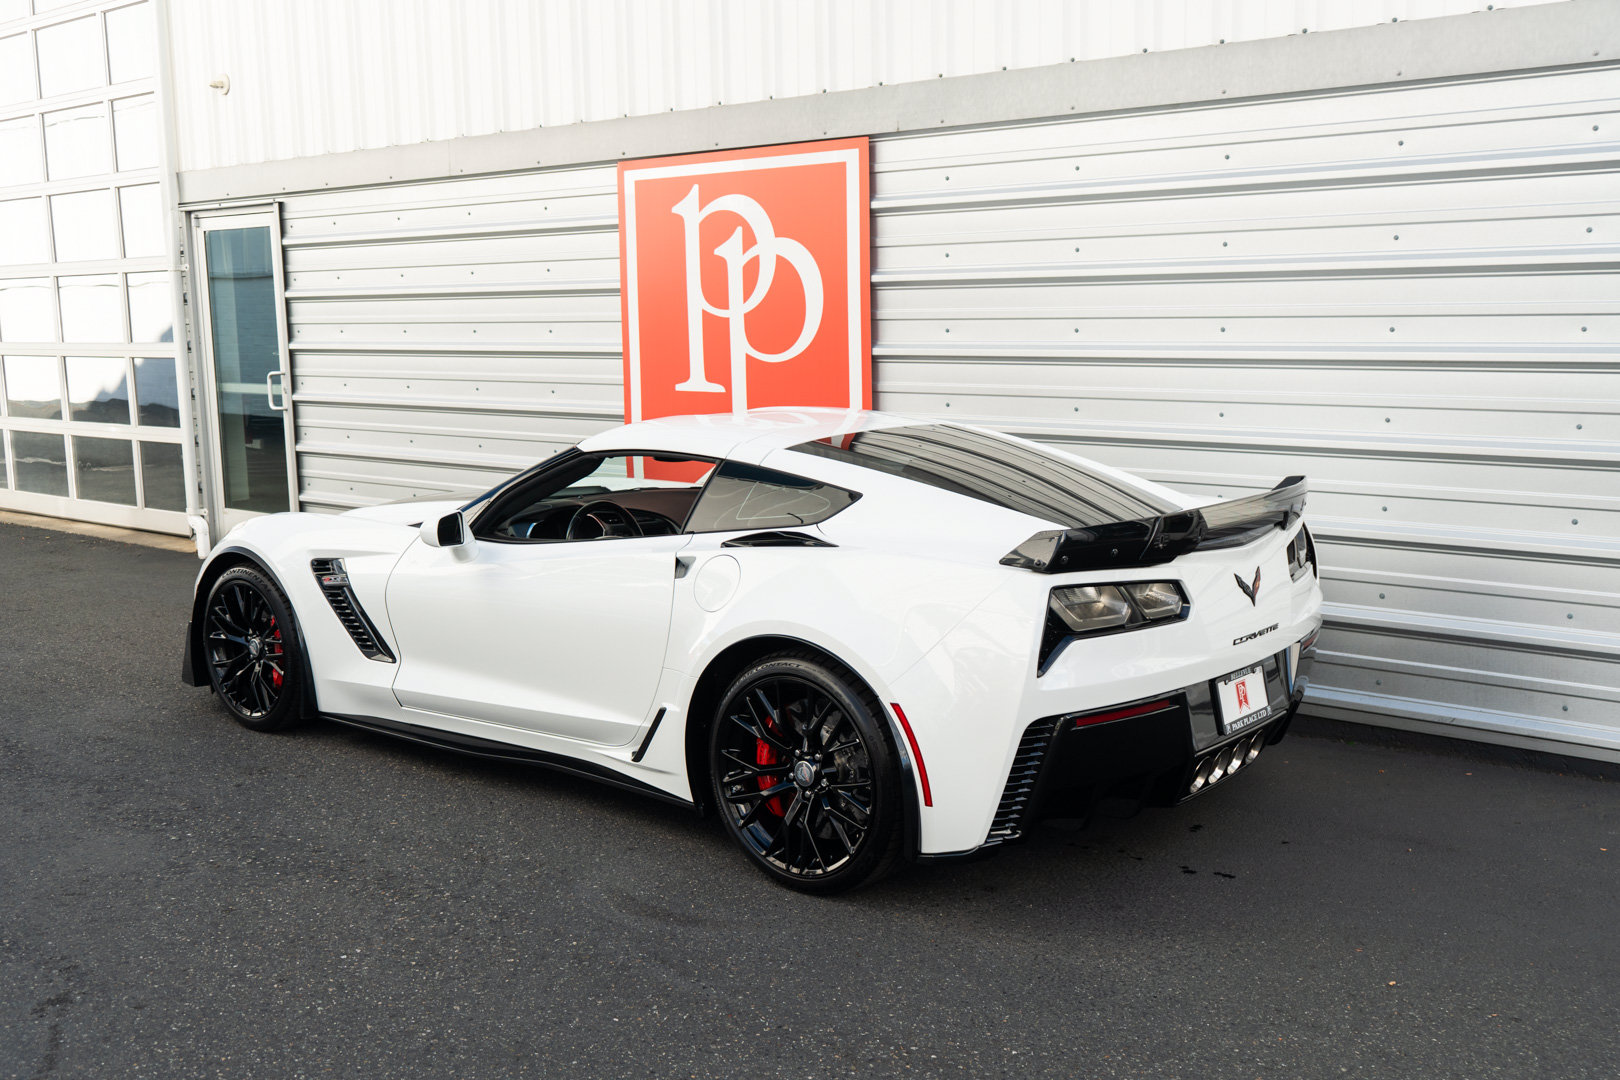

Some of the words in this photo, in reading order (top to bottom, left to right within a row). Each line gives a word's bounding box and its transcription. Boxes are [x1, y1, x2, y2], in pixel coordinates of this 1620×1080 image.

[1233, 622, 1279, 646] CORVETTE
[1232, 721, 1244, 732] PARK
[1244, 714, 1258, 726] PLACE
[1257, 709, 1267, 719] LTD
